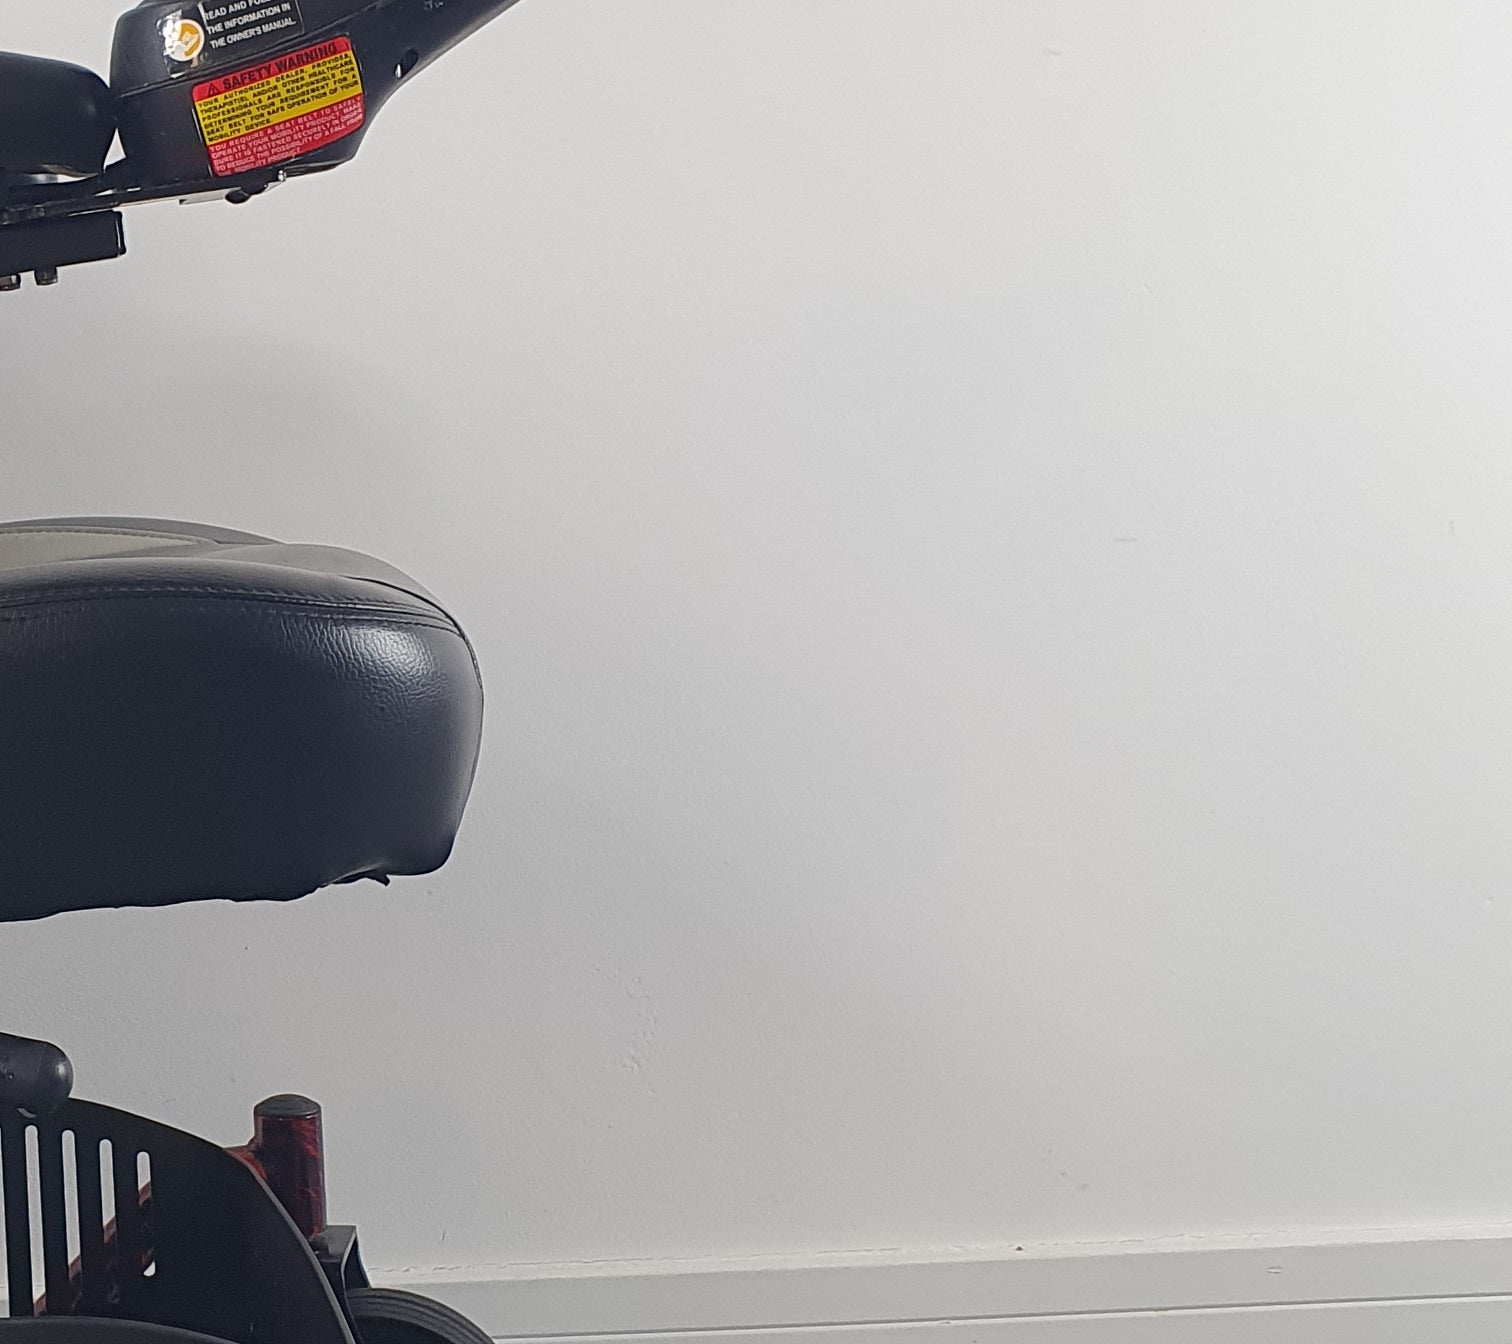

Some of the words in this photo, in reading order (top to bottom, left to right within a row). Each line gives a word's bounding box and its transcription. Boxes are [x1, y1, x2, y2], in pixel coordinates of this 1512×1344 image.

[204, 7, 227, 20] READ
[229, 1, 247, 13] AND
[207, 23, 224, 35] THE
[224, 6, 281, 29] INFORMATION
[281, 2, 291, 12] IN
[210, 37, 226, 49] THE
[226, 26, 261, 44] OWNER'S
[221, 63, 273, 90] SAFETY
[274, 42, 337, 72] WARNING
[227, 118, 246, 128] BELT
